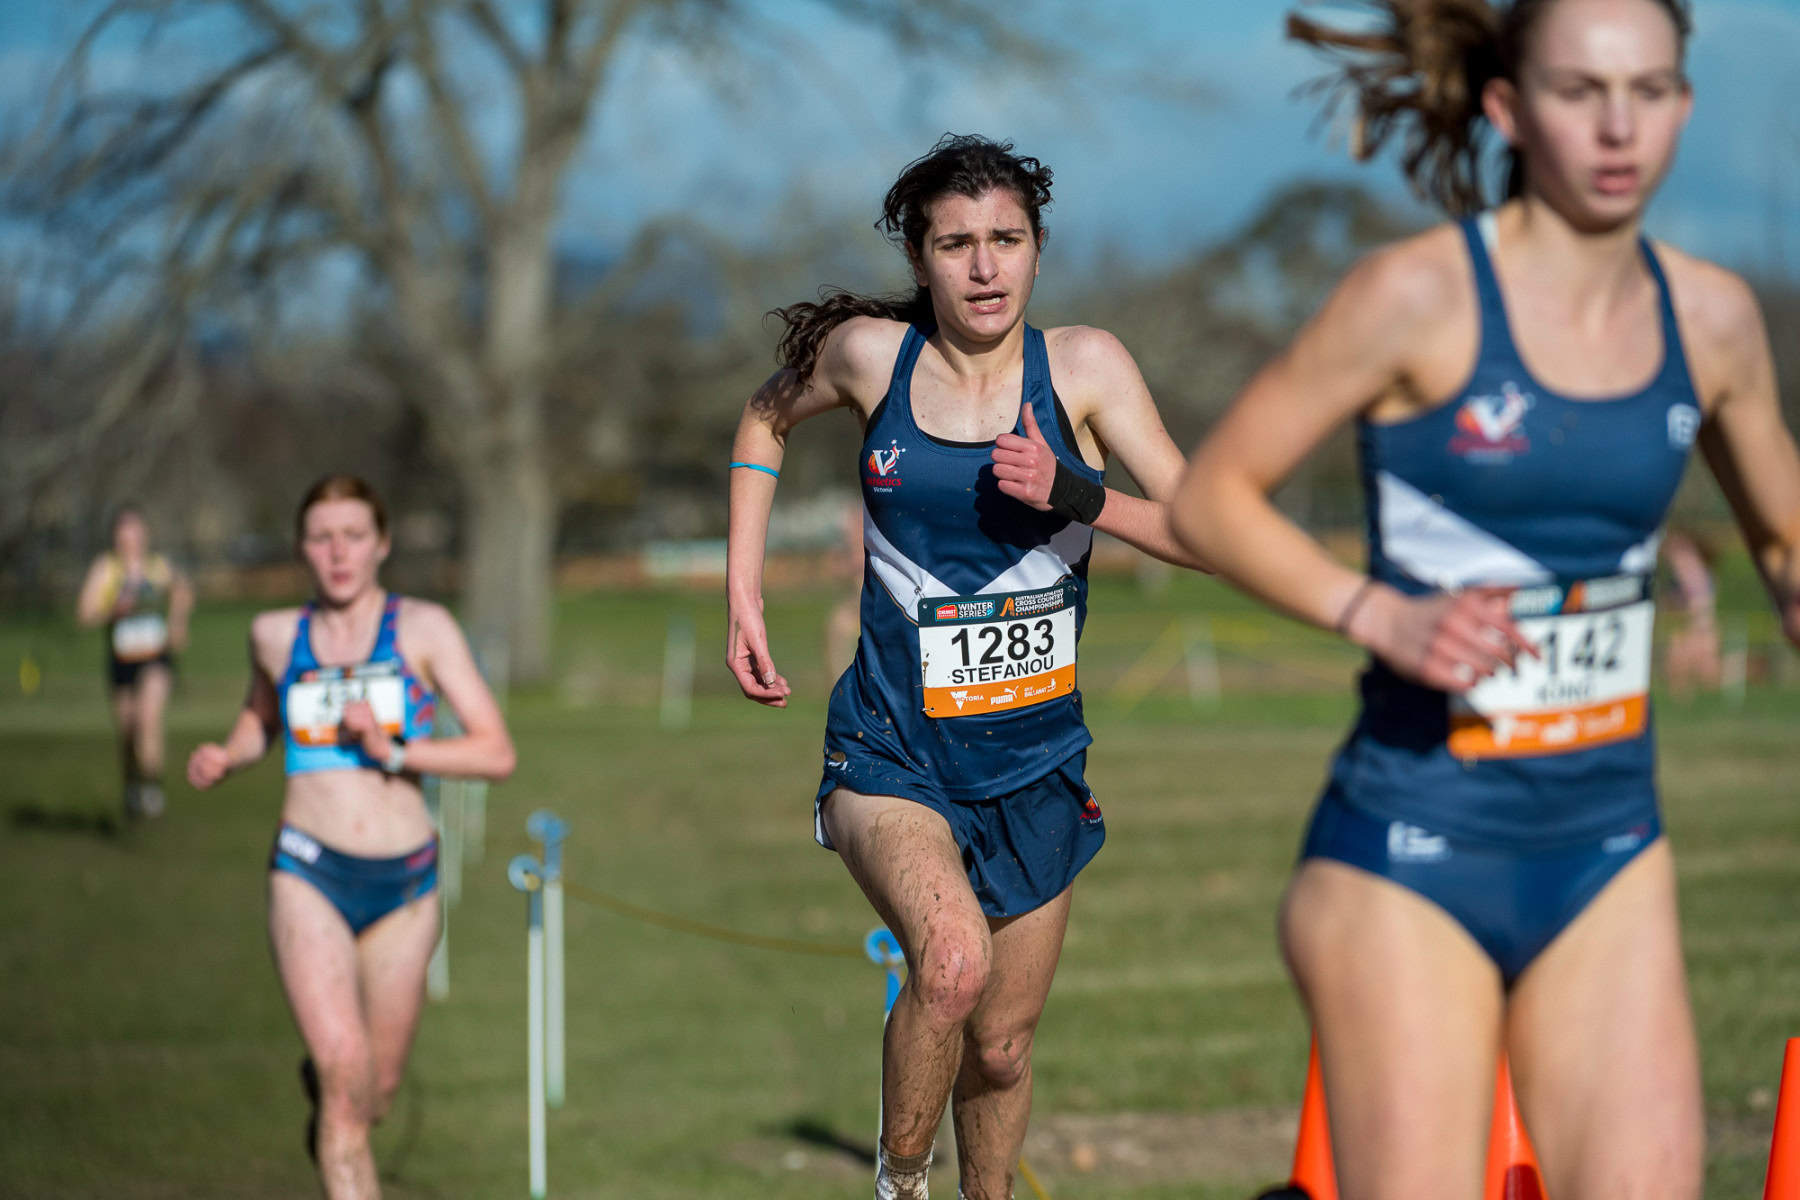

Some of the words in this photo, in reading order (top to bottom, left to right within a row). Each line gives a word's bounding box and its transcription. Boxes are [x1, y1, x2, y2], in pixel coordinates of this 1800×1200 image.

[866, 476, 902, 486] Athletics
[958, 601, 993, 611] WINTER
[1015, 599, 1036, 607] CROSS
[1037, 594, 1064, 603] COUNTRY
[1015, 598, 1064, 613] CHAMPIONSHIPS
[959, 609, 987, 618] SERIES
[951, 619, 1055, 667] 1283
[1510, 617, 1626, 679] 142
[952, 655, 1054, 684] STEFANOU
